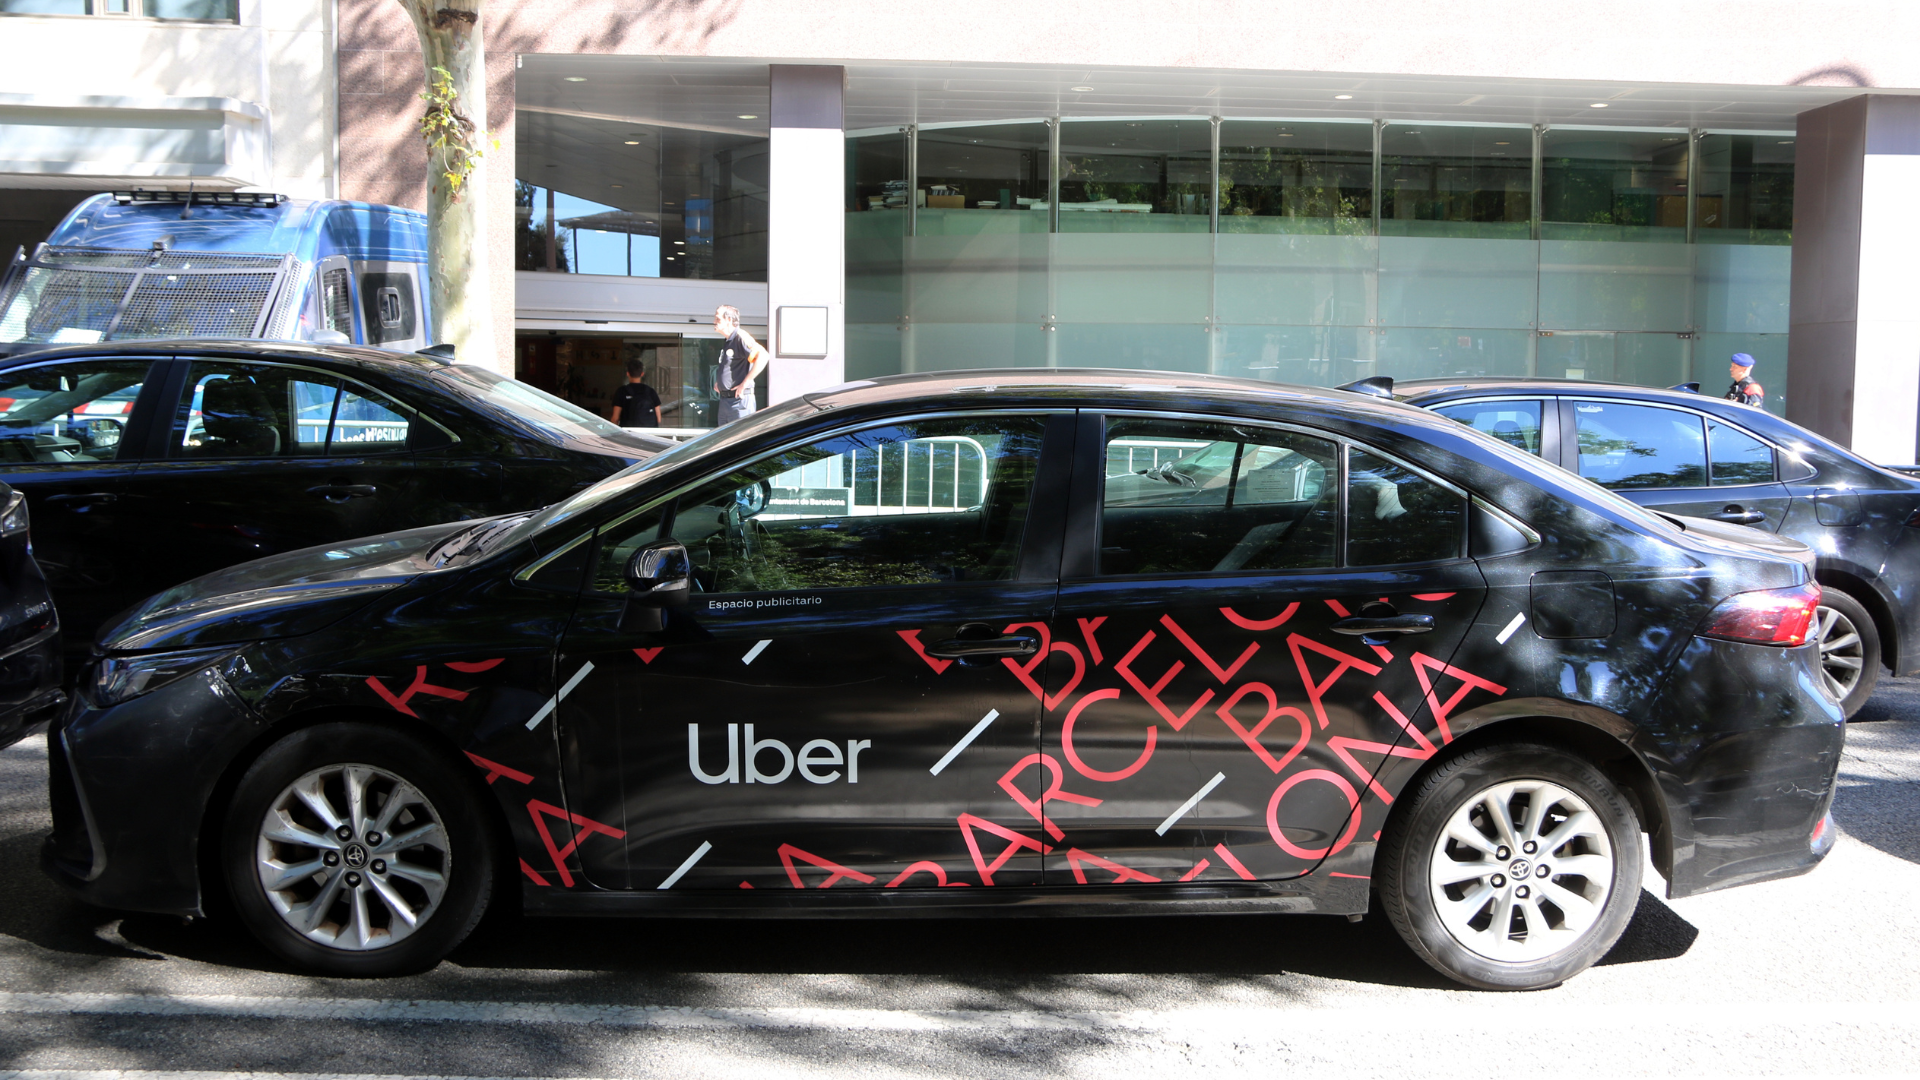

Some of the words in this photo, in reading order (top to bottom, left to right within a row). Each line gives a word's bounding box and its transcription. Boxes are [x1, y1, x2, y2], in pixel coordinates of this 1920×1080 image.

[708, 599, 754, 611] Espacio
[756, 596, 822, 609] publicitario
[687, 723, 872, 785] Uber
